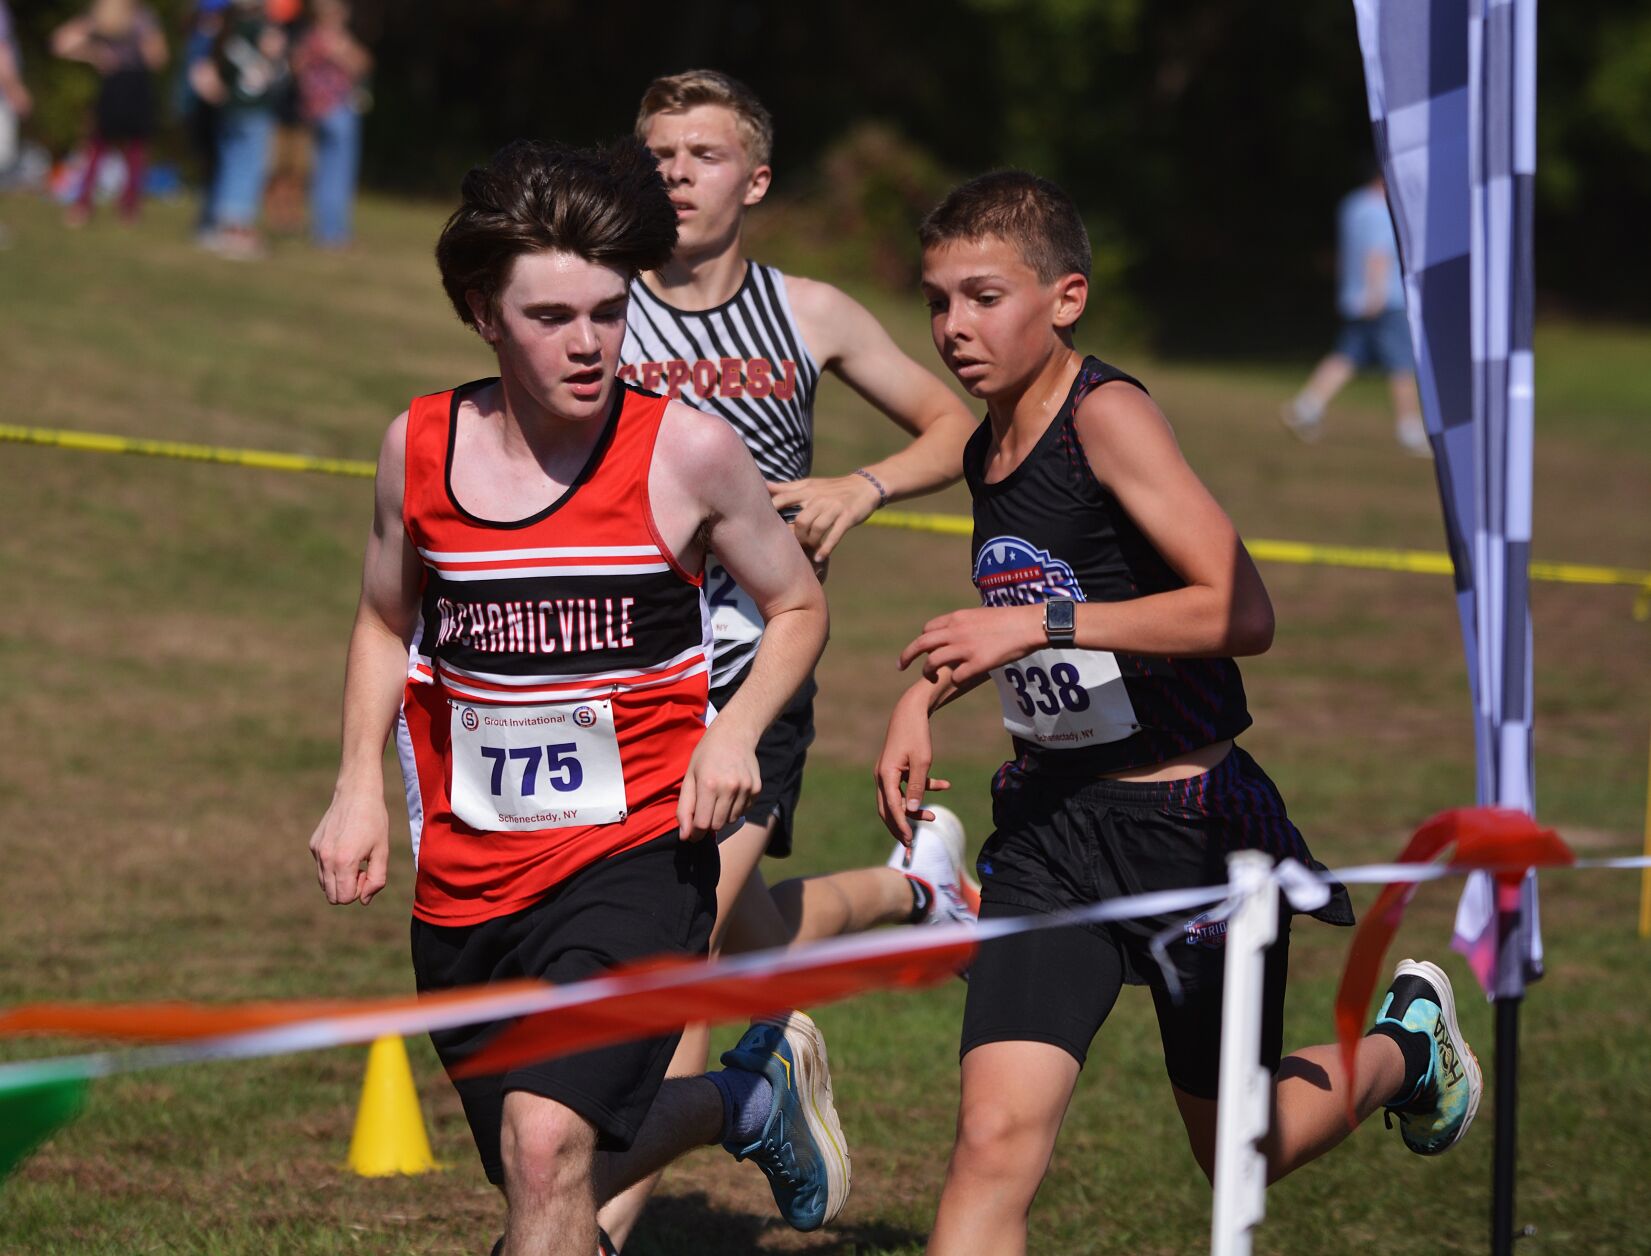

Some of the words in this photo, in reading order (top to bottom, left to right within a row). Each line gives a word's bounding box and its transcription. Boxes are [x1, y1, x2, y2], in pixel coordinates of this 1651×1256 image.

[704, 565, 738, 608] 2
[1004, 662, 1091, 718] 338
[484, 716, 508, 727] Grout
[510, 714, 566, 727] Invitational
[481, 742, 584, 797] 775
[498, 811, 561, 824] Schenectady,
[563, 810, 578, 819] NY
[1188, 921, 1228, 942] PATRIO
